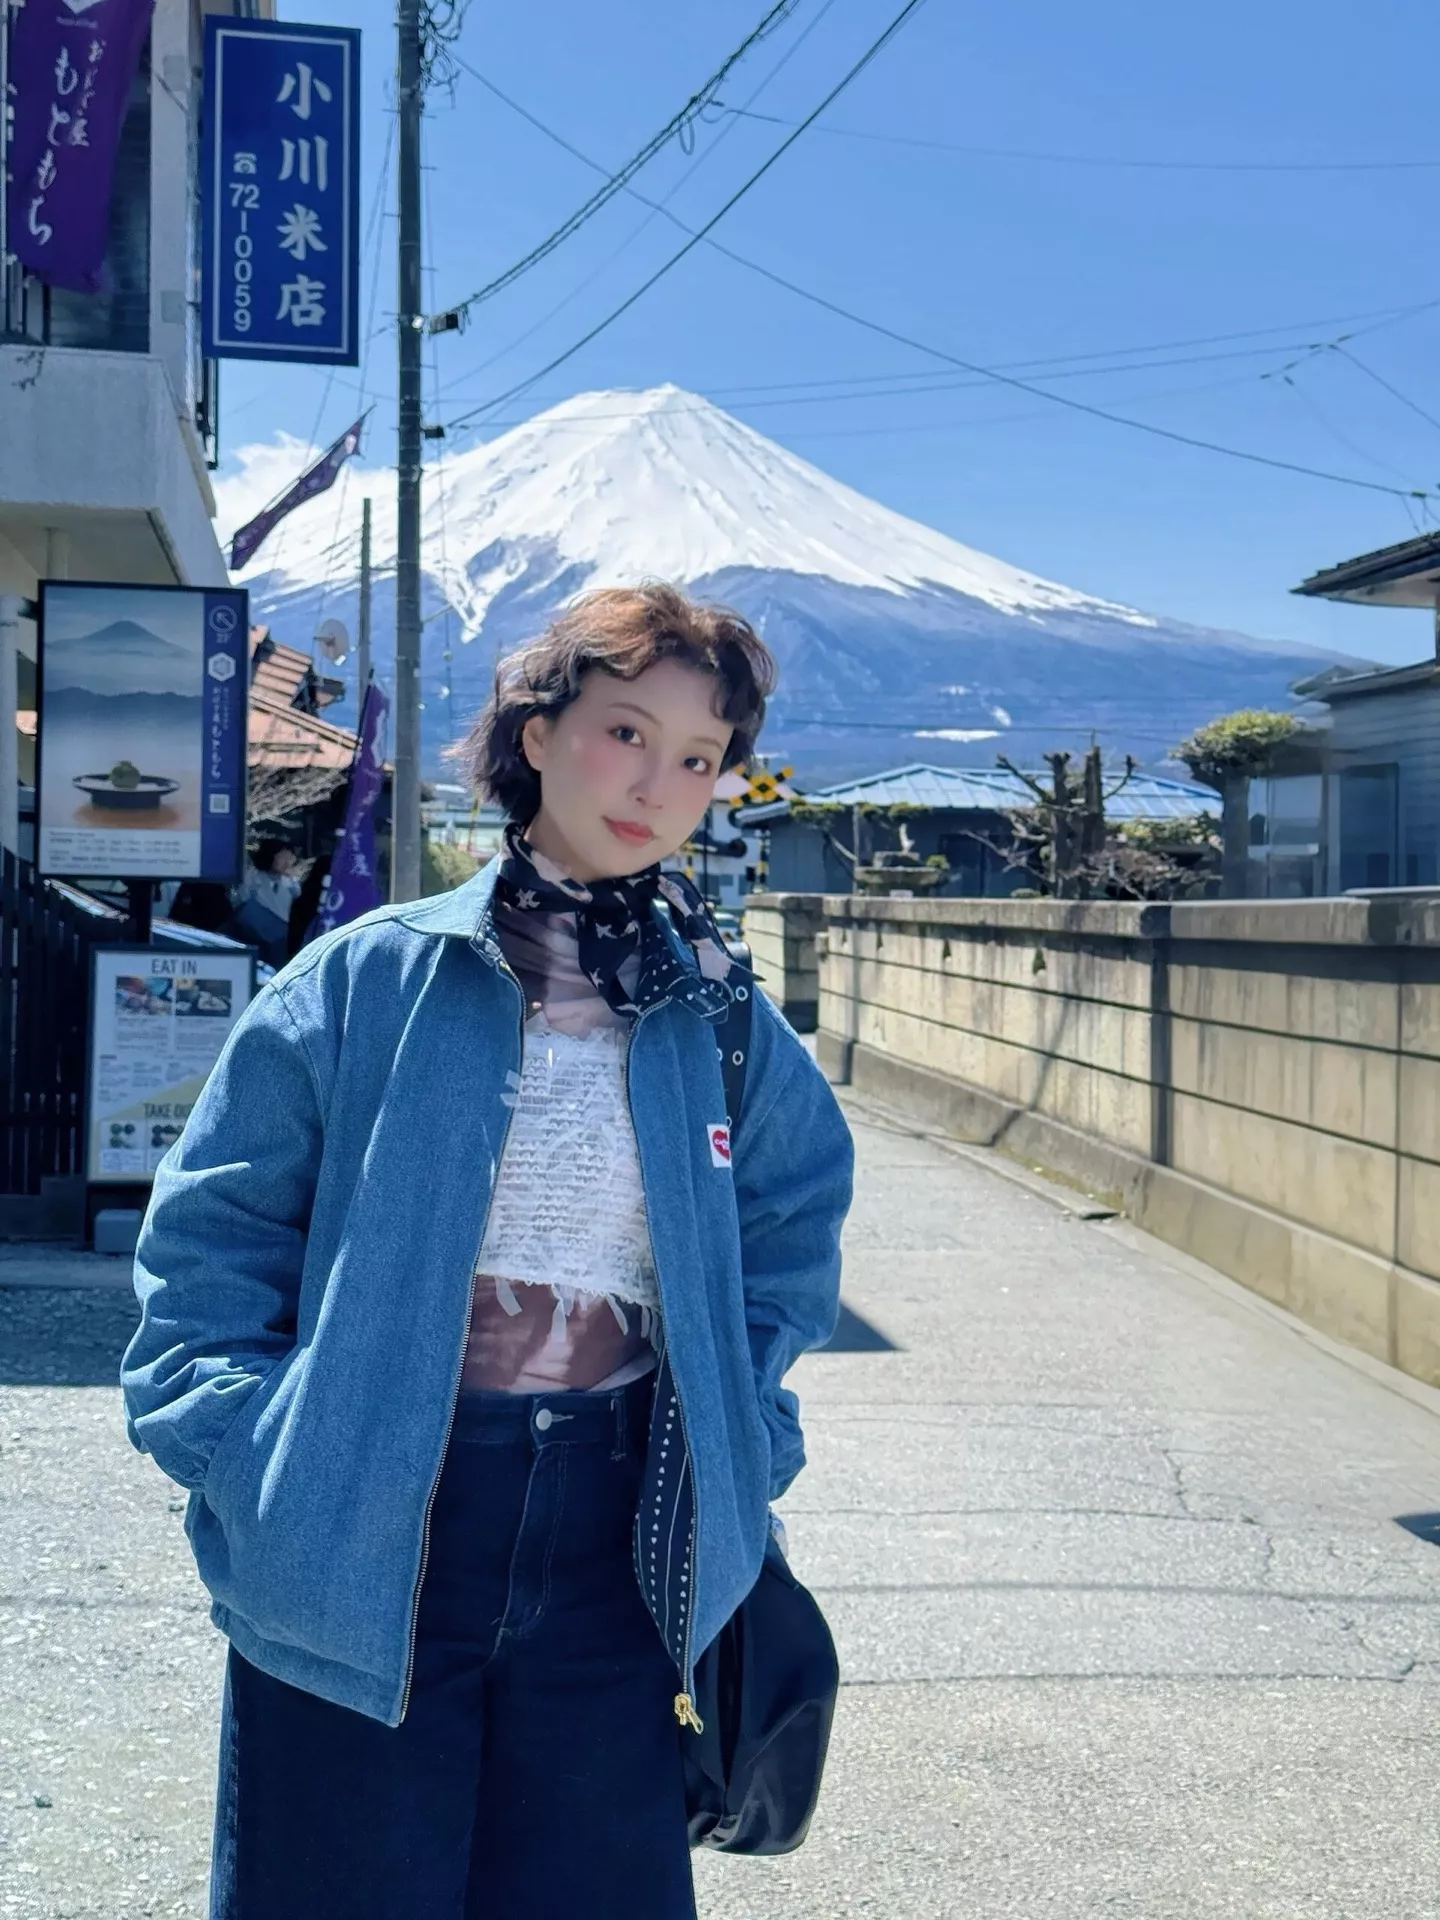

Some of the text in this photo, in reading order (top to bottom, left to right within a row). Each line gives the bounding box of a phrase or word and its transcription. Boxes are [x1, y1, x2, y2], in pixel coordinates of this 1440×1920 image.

[275, 61, 332, 328] 小川米店
[228, 182, 260, 333] 72-0059
[151, 958, 198, 976] EAT IN
[143, 1102, 171, 1119] TAKE
